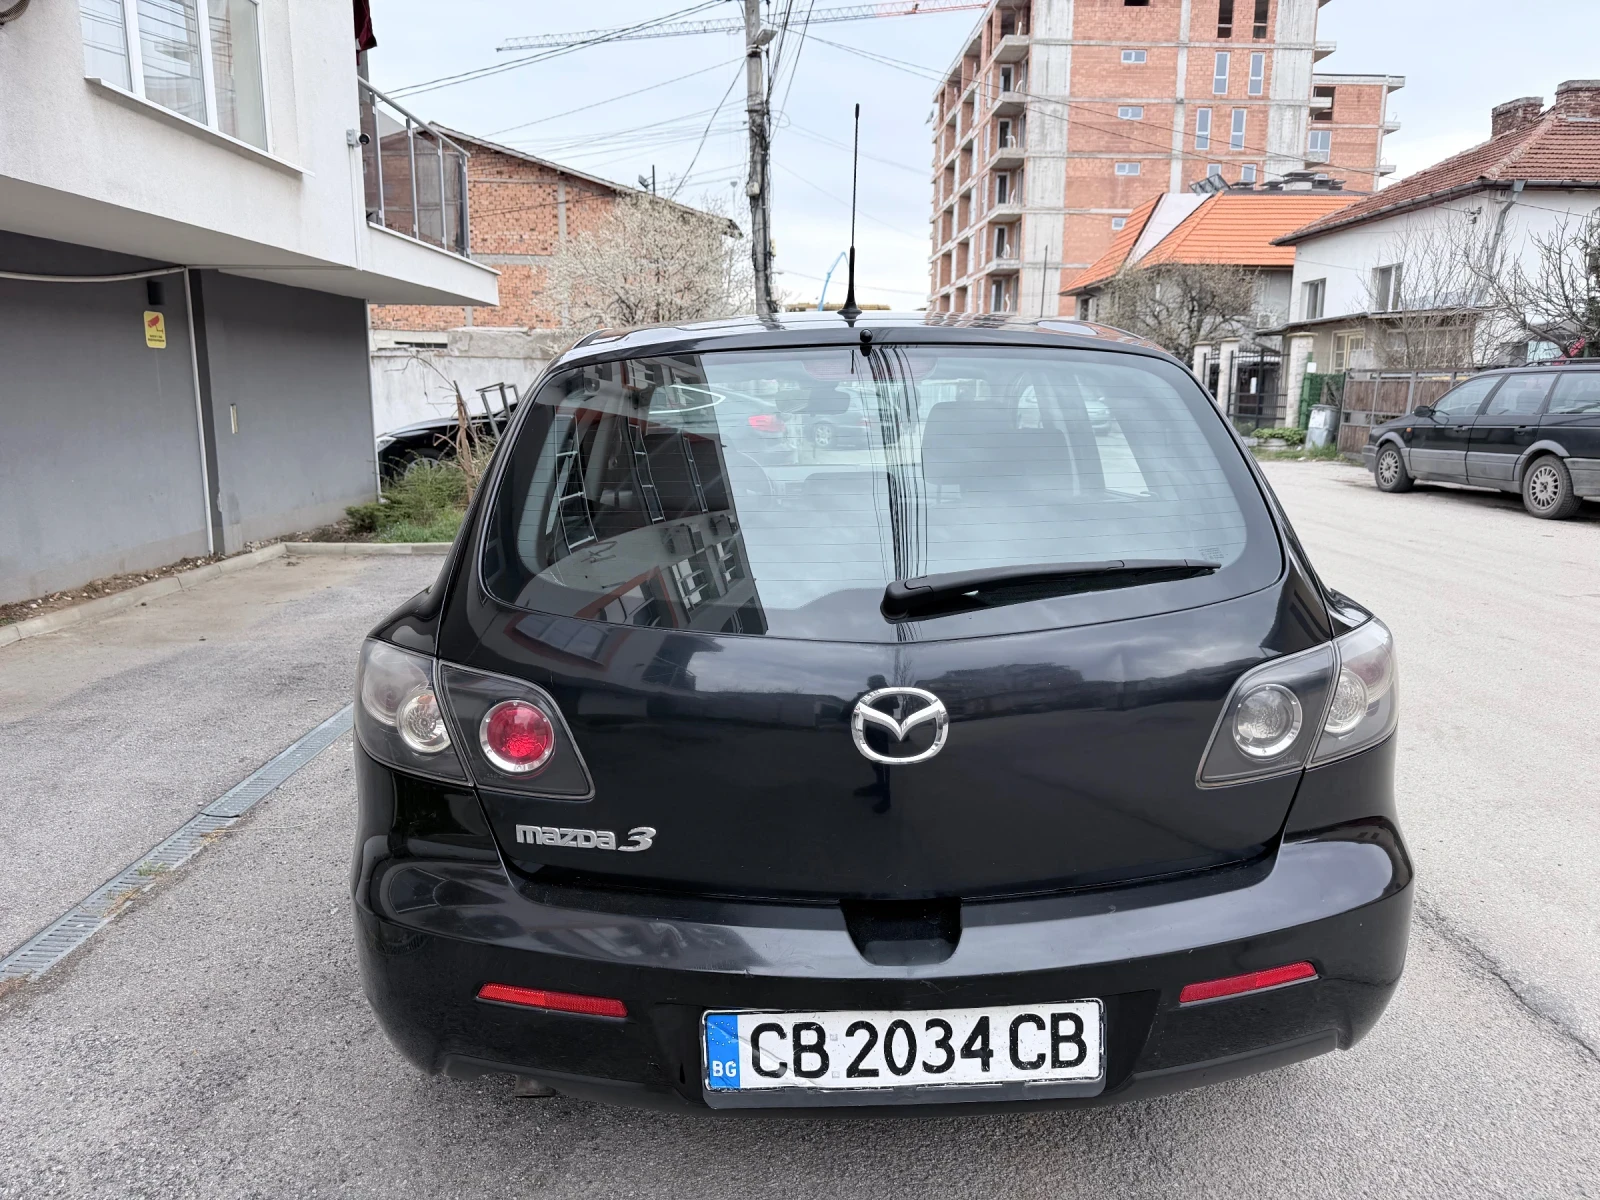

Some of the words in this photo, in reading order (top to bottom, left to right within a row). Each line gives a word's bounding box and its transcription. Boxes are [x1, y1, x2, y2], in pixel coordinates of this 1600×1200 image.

[617, 826, 657, 852] 3
[750, 1021, 830, 1079] CB
[845, 1015, 994, 1078] 2034
[1008, 1012, 1088, 1071] CB
[712, 1060, 737, 1078] BG
